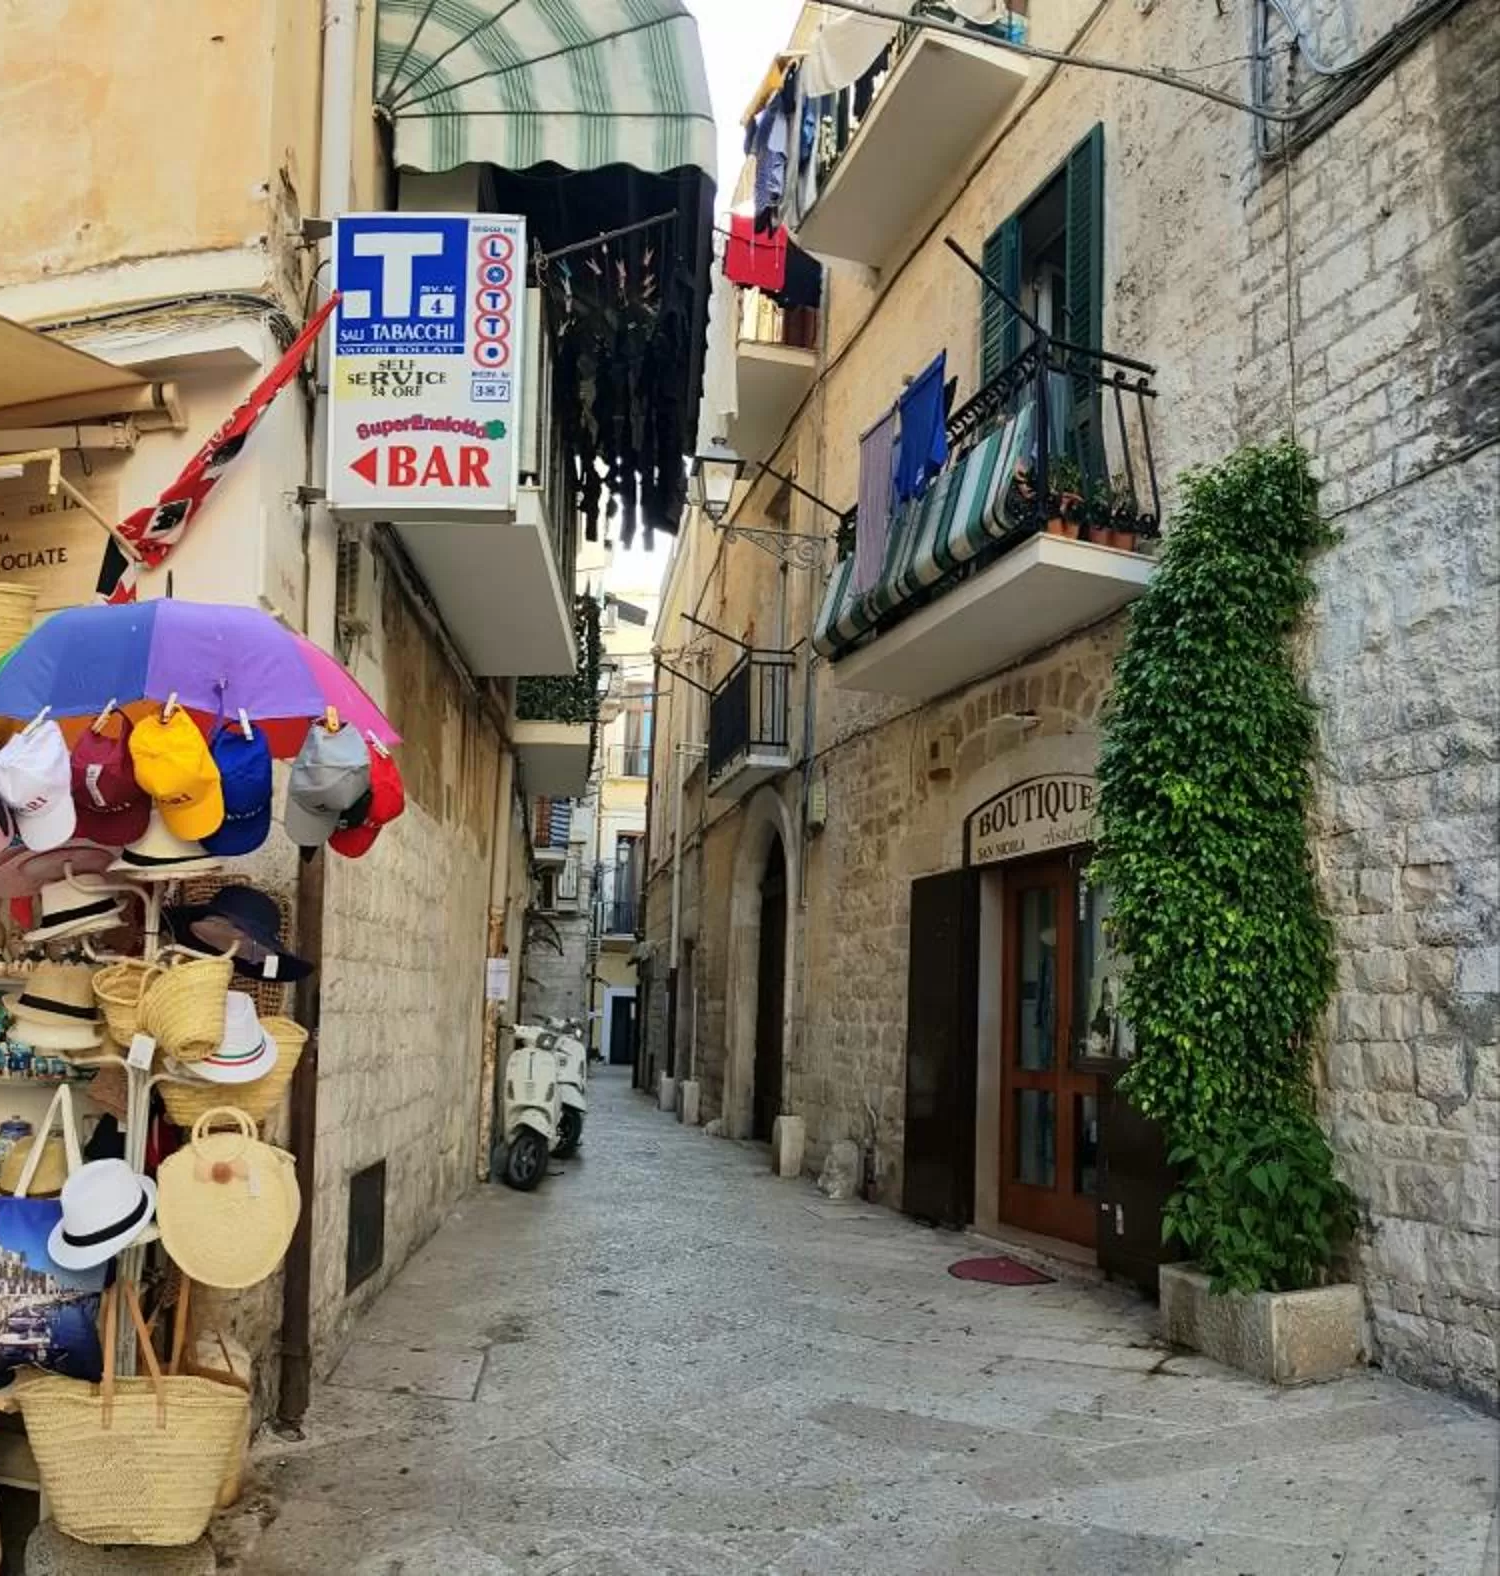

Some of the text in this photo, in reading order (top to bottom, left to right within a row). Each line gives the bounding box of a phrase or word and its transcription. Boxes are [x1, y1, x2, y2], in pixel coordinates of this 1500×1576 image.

[430, 299, 443, 314] 4
[340, 323, 455, 341] SALI TABACCHI
[339, 345, 455, 355] VALORI BOLLATI
[378, 360, 416, 371] SELF
[347, 371, 447, 385] SERVICE
[371, 385, 422, 397] 24 ORE
[356, 413, 488, 440] SuperEnalotto
[387, 445, 492, 487] BAR
[979, 781, 1094, 837] BOUTIQUE
